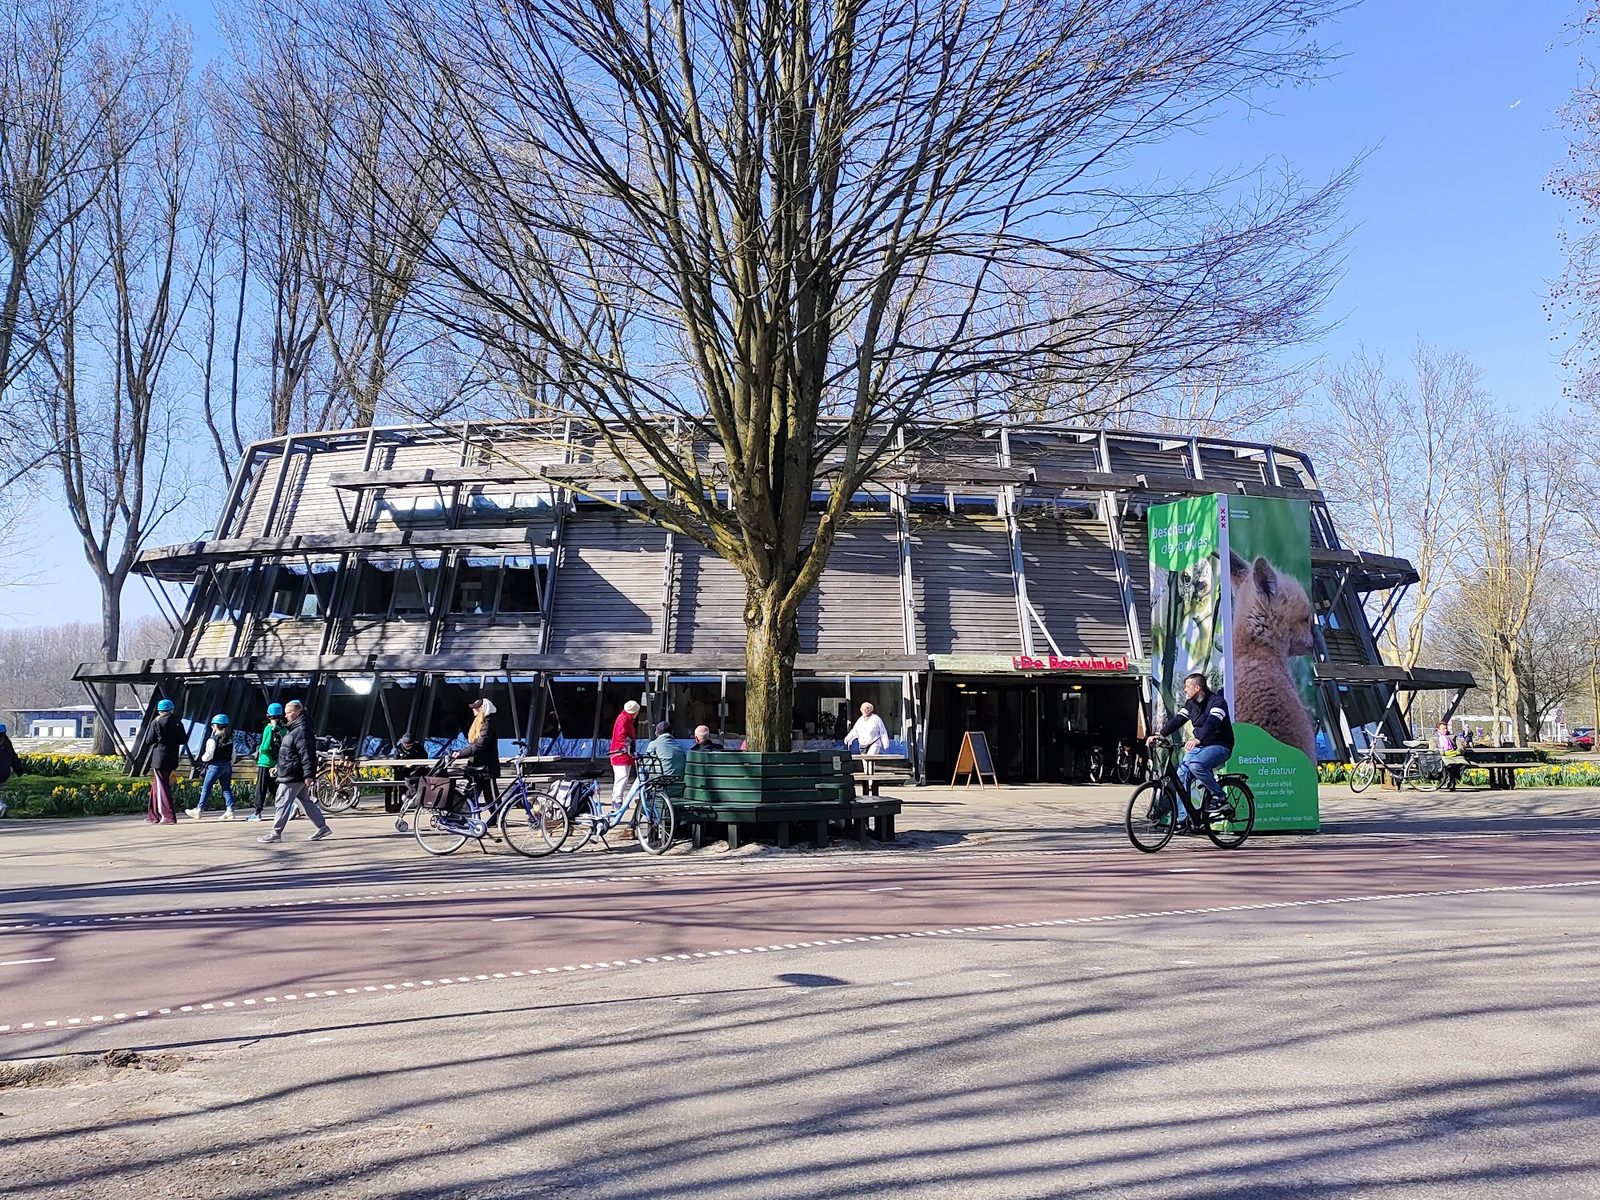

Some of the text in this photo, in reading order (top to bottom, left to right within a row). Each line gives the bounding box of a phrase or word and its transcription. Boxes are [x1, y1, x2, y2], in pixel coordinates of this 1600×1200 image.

[1152, 521, 1196, 539] Bescherm
[1161, 541, 1174, 555] de
[1020, 655, 1043, 670] De
[1049, 655, 1129, 672] Boswinkel
[1238, 755, 1277, 765] Bescherm
[1258, 767, 1296, 776] de natuur
